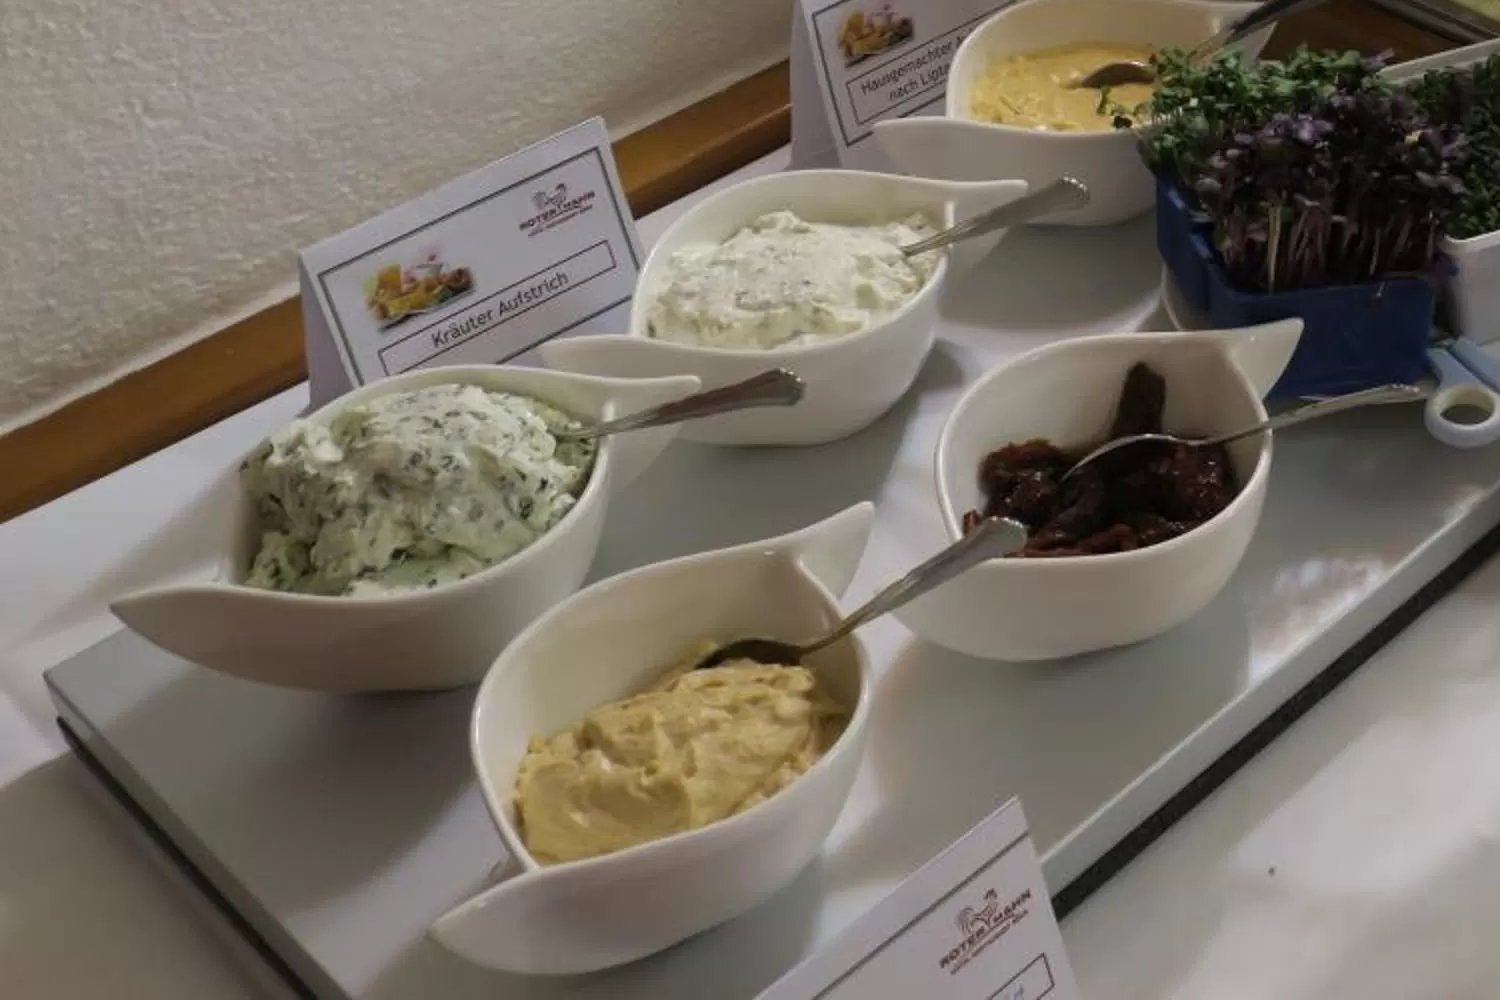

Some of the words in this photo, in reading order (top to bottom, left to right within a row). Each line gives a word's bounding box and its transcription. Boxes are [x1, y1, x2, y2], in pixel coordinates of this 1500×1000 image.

[920, 63, 950, 86] Lipta
[431, 309, 493, 348] Kräuter
[499, 271, 569, 317] Aufstrich
